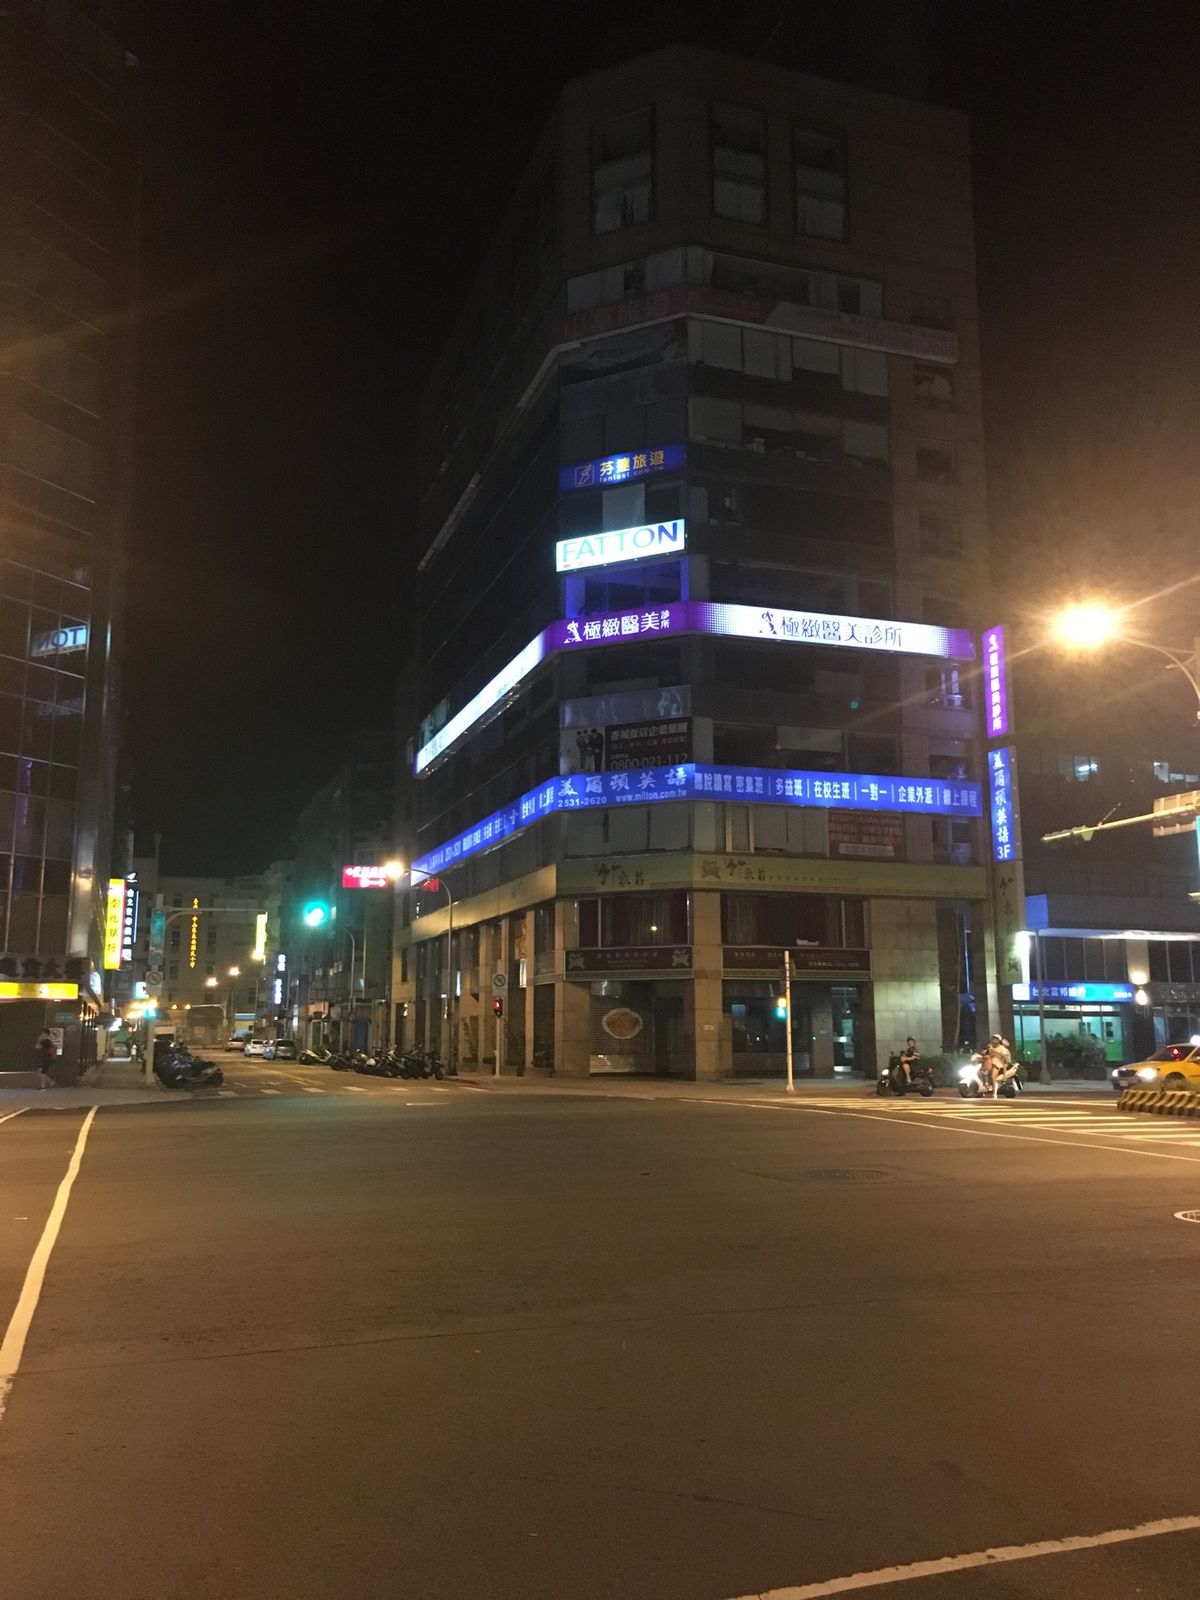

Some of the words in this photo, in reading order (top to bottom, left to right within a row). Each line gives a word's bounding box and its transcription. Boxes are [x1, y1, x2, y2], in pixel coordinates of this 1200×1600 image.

[600, 450, 664, 476] 芬達旅遊
[563, 522, 678, 562] FATTON
[780, 616, 902, 648] 極緻醫美診所
[558, 796, 607, 808] 2531-2620
[616, 788, 688, 803] www.milton.com.tw
[775, 777, 803, 797] 多益班
[813, 780, 850, 800] 在校生班
[861, 783, 888, 801] 一對一
[898, 785, 934, 805] 企業外派
[996, 845, 1011, 860] 3F
